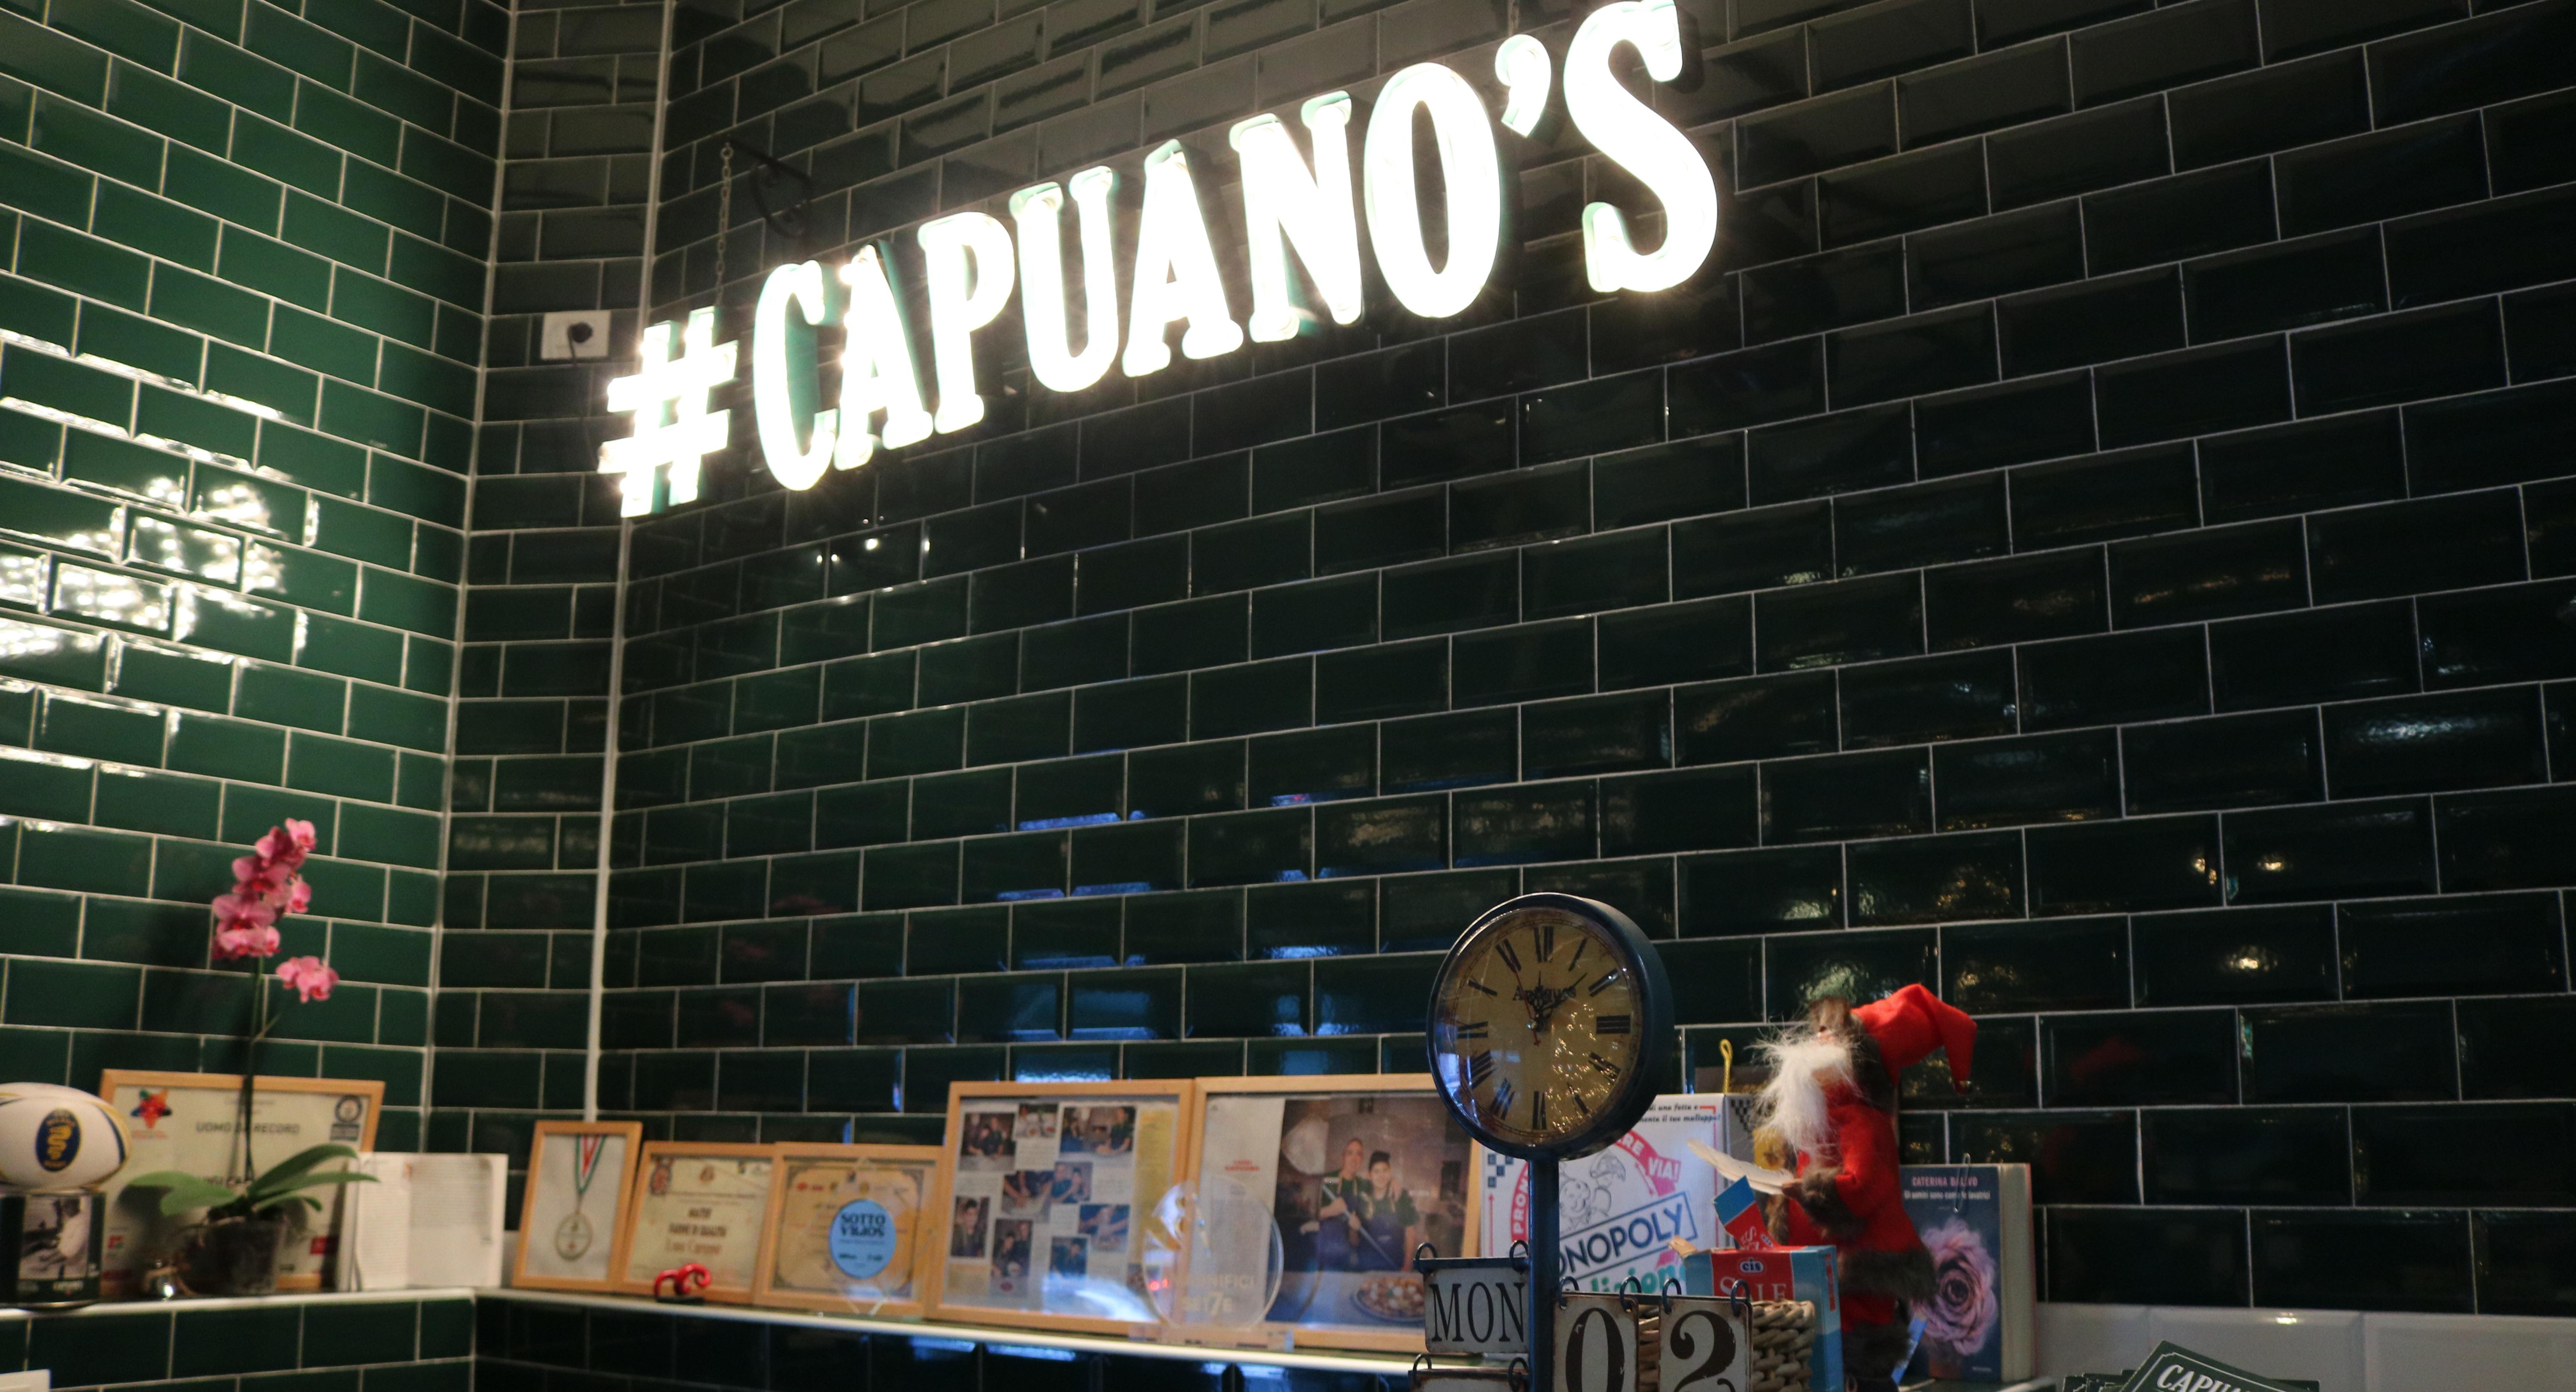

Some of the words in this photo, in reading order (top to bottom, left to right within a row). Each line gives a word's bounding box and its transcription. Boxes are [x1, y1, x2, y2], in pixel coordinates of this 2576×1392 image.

[595, 0, 1716, 517] #CAPUANO'S
[1559, 1203, 1683, 1276] NOPOLY
[1742, 1257, 1761, 1272] cis
[1429, 1281, 1525, 1343] MON
